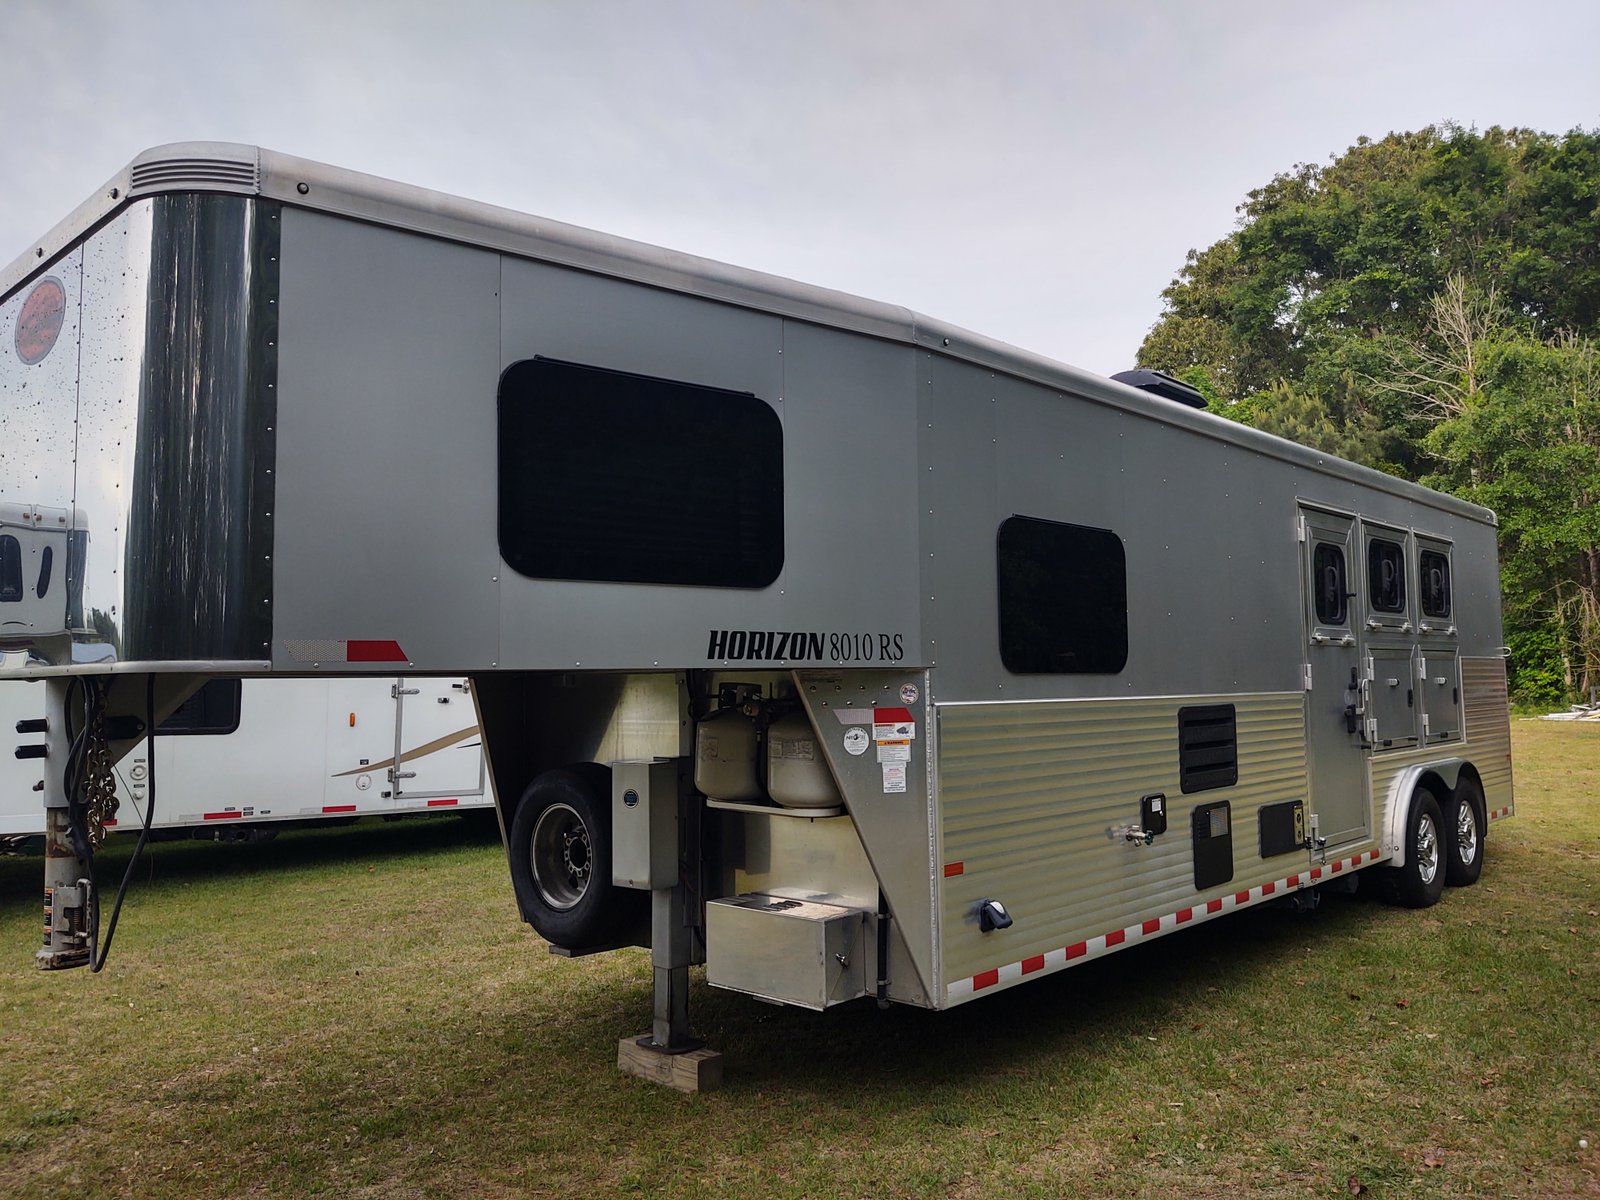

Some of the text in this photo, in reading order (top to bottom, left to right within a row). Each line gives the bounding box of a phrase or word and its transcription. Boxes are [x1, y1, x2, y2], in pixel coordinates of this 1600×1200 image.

[707, 630, 904, 661] HORIZON 8010 RS
